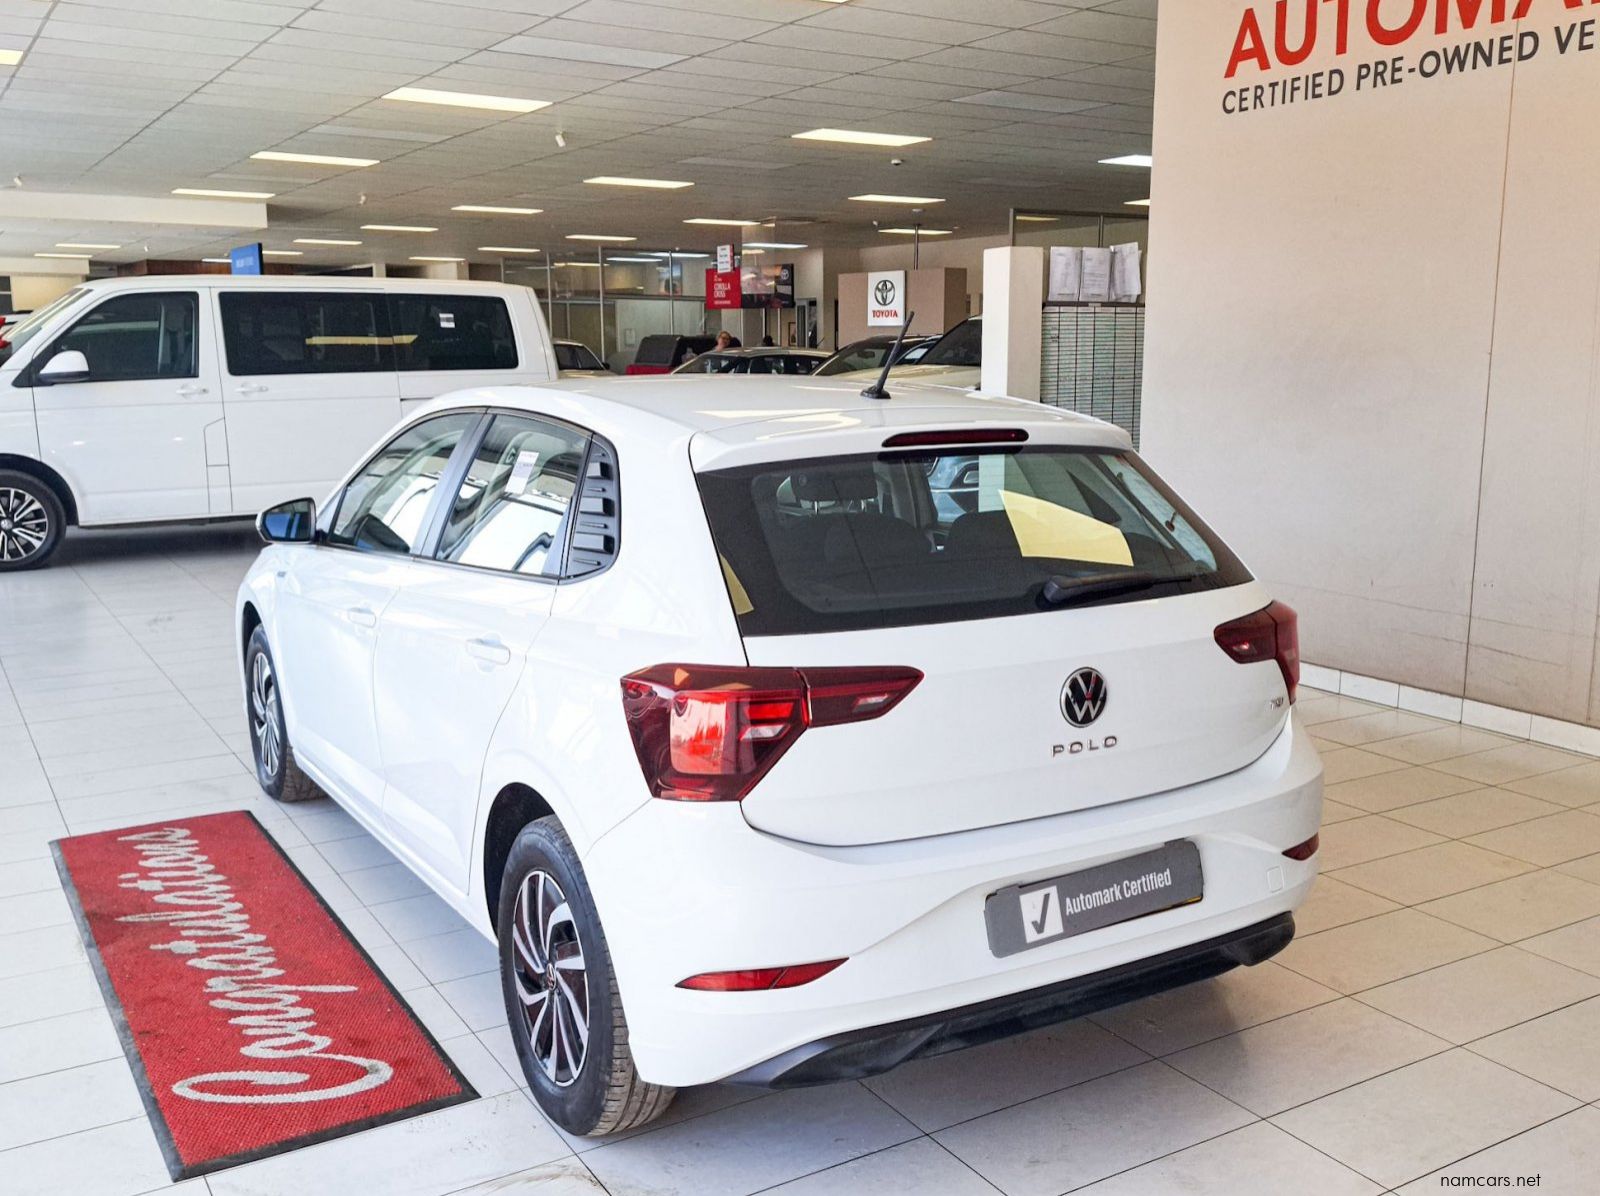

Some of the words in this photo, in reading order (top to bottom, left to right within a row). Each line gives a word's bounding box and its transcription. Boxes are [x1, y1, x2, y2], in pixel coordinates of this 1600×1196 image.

[1224, 0, 1600, 79] AUTO
[1222, 68, 1345, 115] CERTIFIED
[1356, 31, 1540, 91] PRE-OWNED
[872, 310, 898, 318] TOYOTA
[1052, 735, 1118, 758] POLO
[1065, 884, 1122, 916] Automark
[1123, 868, 1172, 899] Certified
[115, 827, 394, 1104] Congratulations
